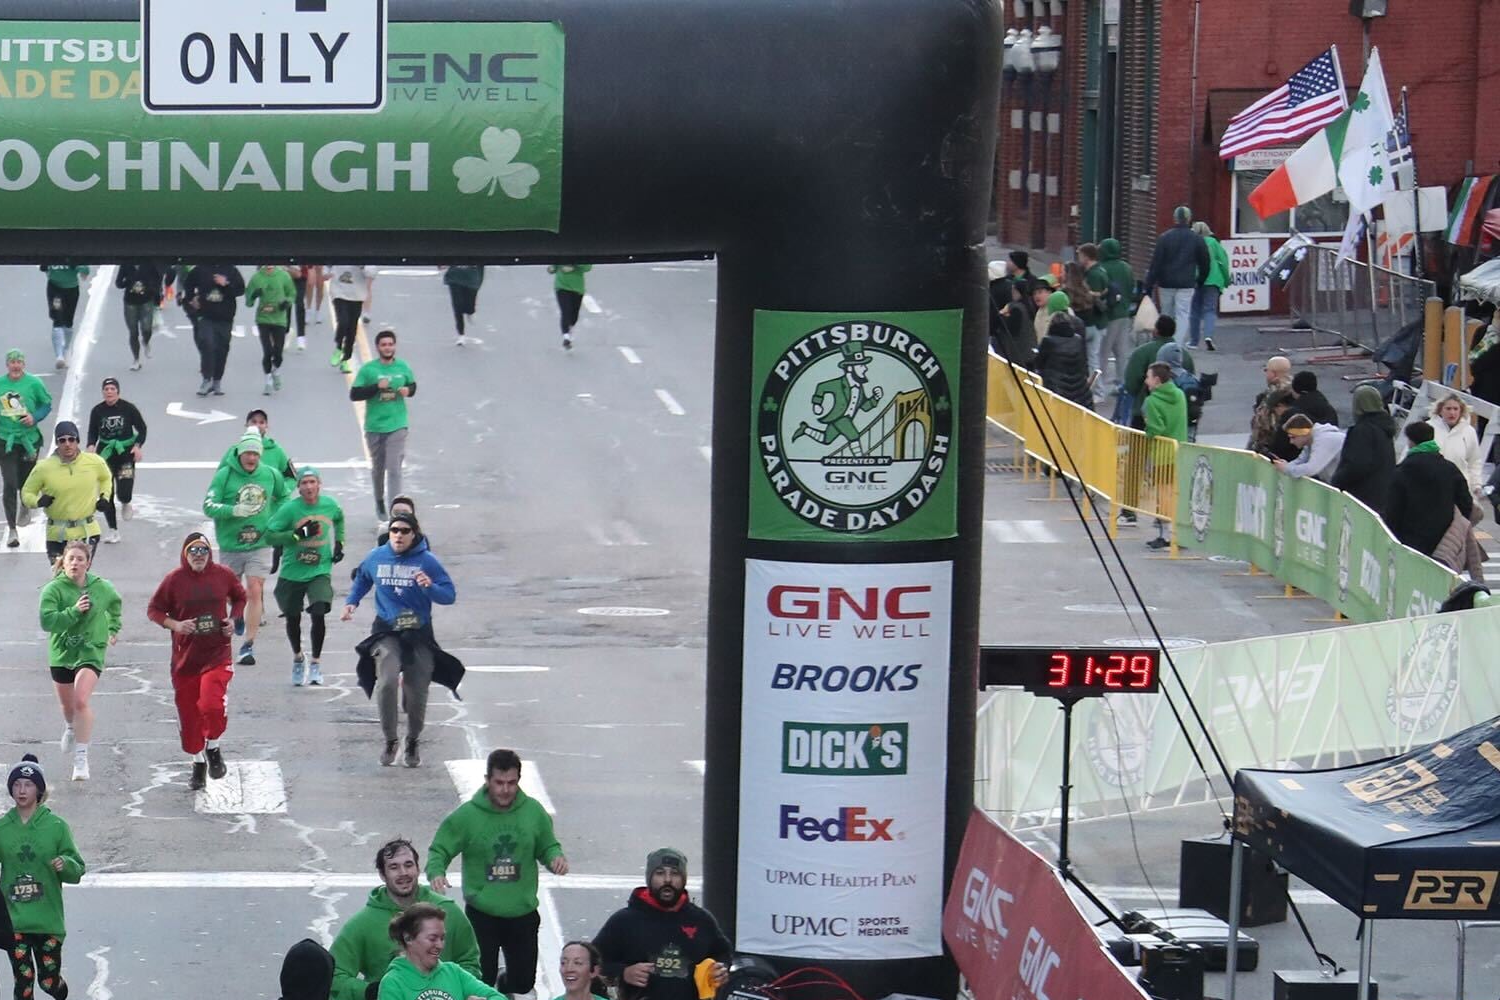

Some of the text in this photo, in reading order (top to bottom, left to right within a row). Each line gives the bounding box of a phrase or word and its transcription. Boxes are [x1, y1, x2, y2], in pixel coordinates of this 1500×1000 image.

[180, 32, 350, 84] ONLY
[387, 53, 539, 83] GNC
[89, 70, 140, 99] DA
[389, 88, 538, 102] IVE WELL
[1232, 245, 1257, 255] ALL
[1232, 258, 1258, 268] DAY
[1230, 271, 1267, 286] ARKING
[775, 324, 940, 381] PITTSBURGH
[824, 457, 889, 465] PRESENTED BY
[761, 435, 949, 531] PARADE DAY DASH
[825, 471, 887, 484] GNC
[767, 584, 932, 620] GNC
[769, 623, 931, 639] LIVE WELL
[771, 663, 923, 692] BROOKS
[788, 725, 902, 769] DICK'S
[779, 804, 894, 842] FedEx
[765, 869, 817, 886] UPMC
[963, 867, 1014, 939] GNC
[771, 914, 848, 937] UPMC
[858, 917, 900, 926] SPORTS
[858, 927, 909, 937] MEDICINE
[655, 957, 681, 969] 592
